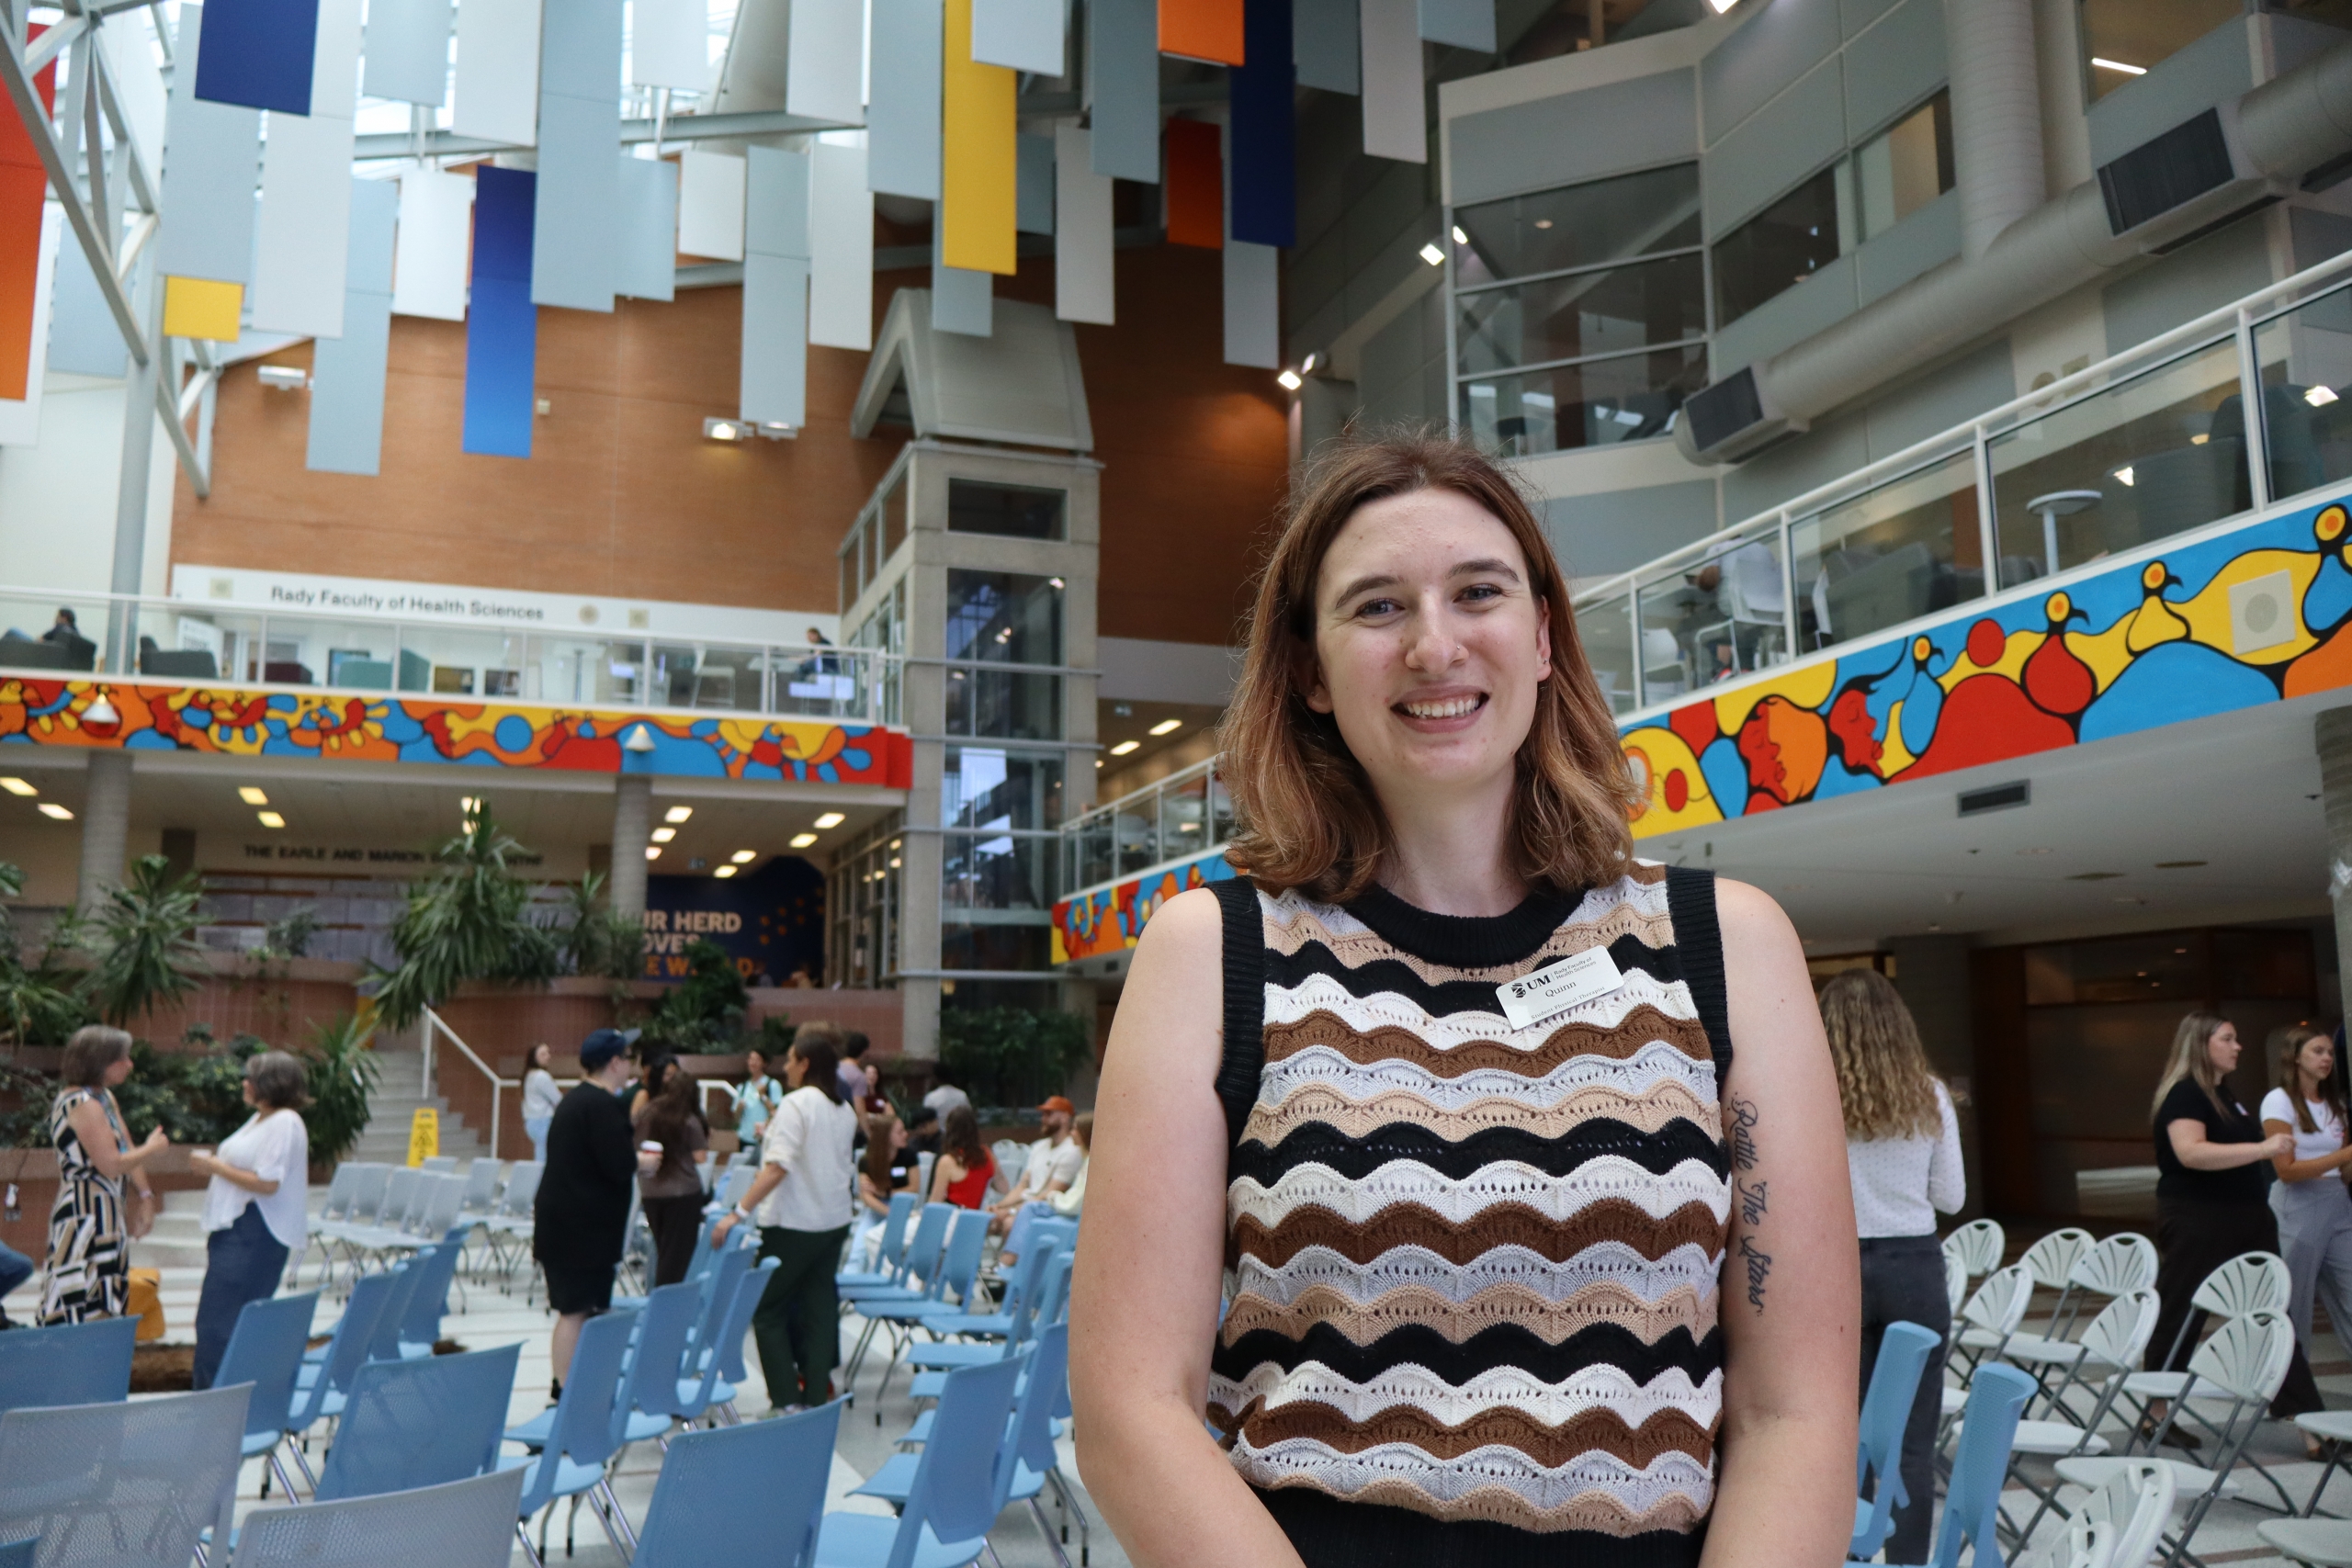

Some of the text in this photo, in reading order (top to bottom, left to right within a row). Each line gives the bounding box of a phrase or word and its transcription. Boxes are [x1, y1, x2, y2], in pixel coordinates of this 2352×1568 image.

[271, 585, 544, 620] Rady Faculty of Health Sciences
[673, 910, 742, 934] HERD
[1554, 966, 1567, 976] Rady
[1567, 960, 1586, 971] Faculty
[1555, 961, 1597, 980] Health Sciences
[1526, 974, 1551, 989] UM
[1544, 981, 1577, 998] Quinn
[1531, 987, 1606, 1020] Student Physical Therapist
[1729, 1100, 1772, 1311] Rattle The Stars
